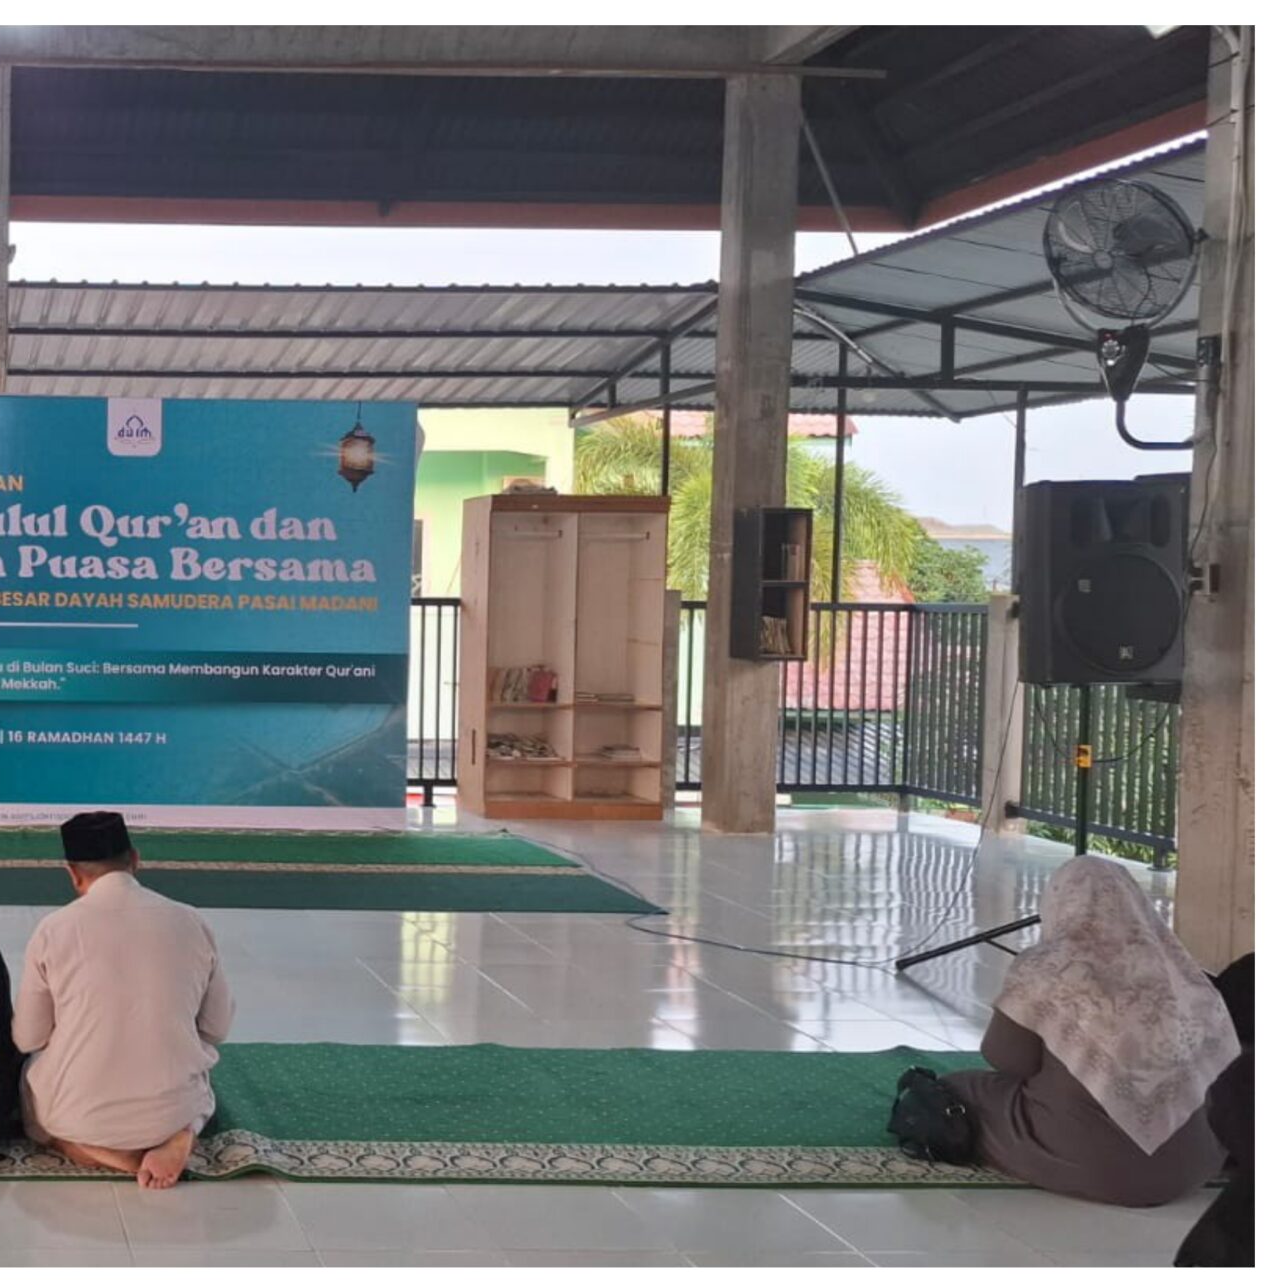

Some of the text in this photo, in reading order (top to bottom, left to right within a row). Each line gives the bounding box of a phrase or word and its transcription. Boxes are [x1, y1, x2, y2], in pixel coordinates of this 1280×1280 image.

[80, 502, 242, 547] Qur’an
[250, 507, 338, 540] dan
[18, 545, 159, 579] Puasa
[170, 547, 377, 582] Bersama
[54, 592, 123, 608] DAYAH
[127, 592, 233, 609] SAMUDERA
[237, 594, 295, 610] PASAI
[300, 595, 378, 611] MADANI
[6, 661, 20, 673] di
[23, 661, 63, 674] Bulan
[66, 662, 99, 674] Suci:
[102, 662, 166, 675] Bersama
[168, 663, 259, 679] Membangun
[262, 664, 323, 676] Karakter
[325, 664, 376, 678] Qur'ani
[8, 730, 23, 743] 16
[27, 730, 114, 744] RAMADHAN
[119, 731, 151, 744] 1447
[155, 732, 166, 744] H
